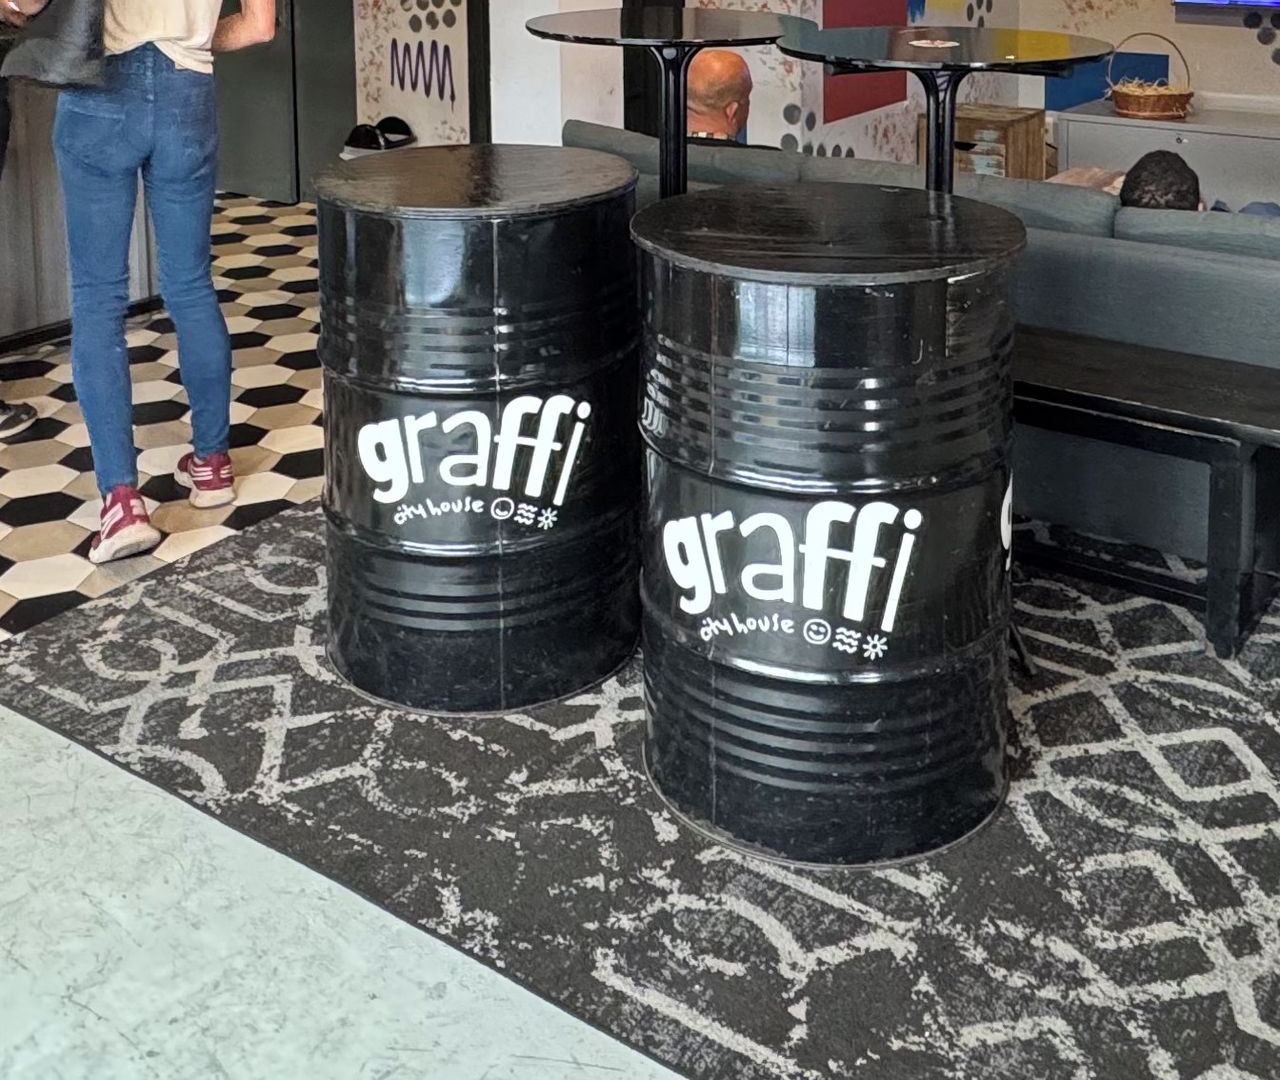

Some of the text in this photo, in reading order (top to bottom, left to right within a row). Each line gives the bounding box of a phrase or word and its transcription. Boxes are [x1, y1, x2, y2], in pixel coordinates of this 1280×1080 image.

[358, 395, 591, 506] graffi
[394, 497, 485, 525] city house
[663, 500, 922, 632] graffi
[700, 613, 795, 641] city house
